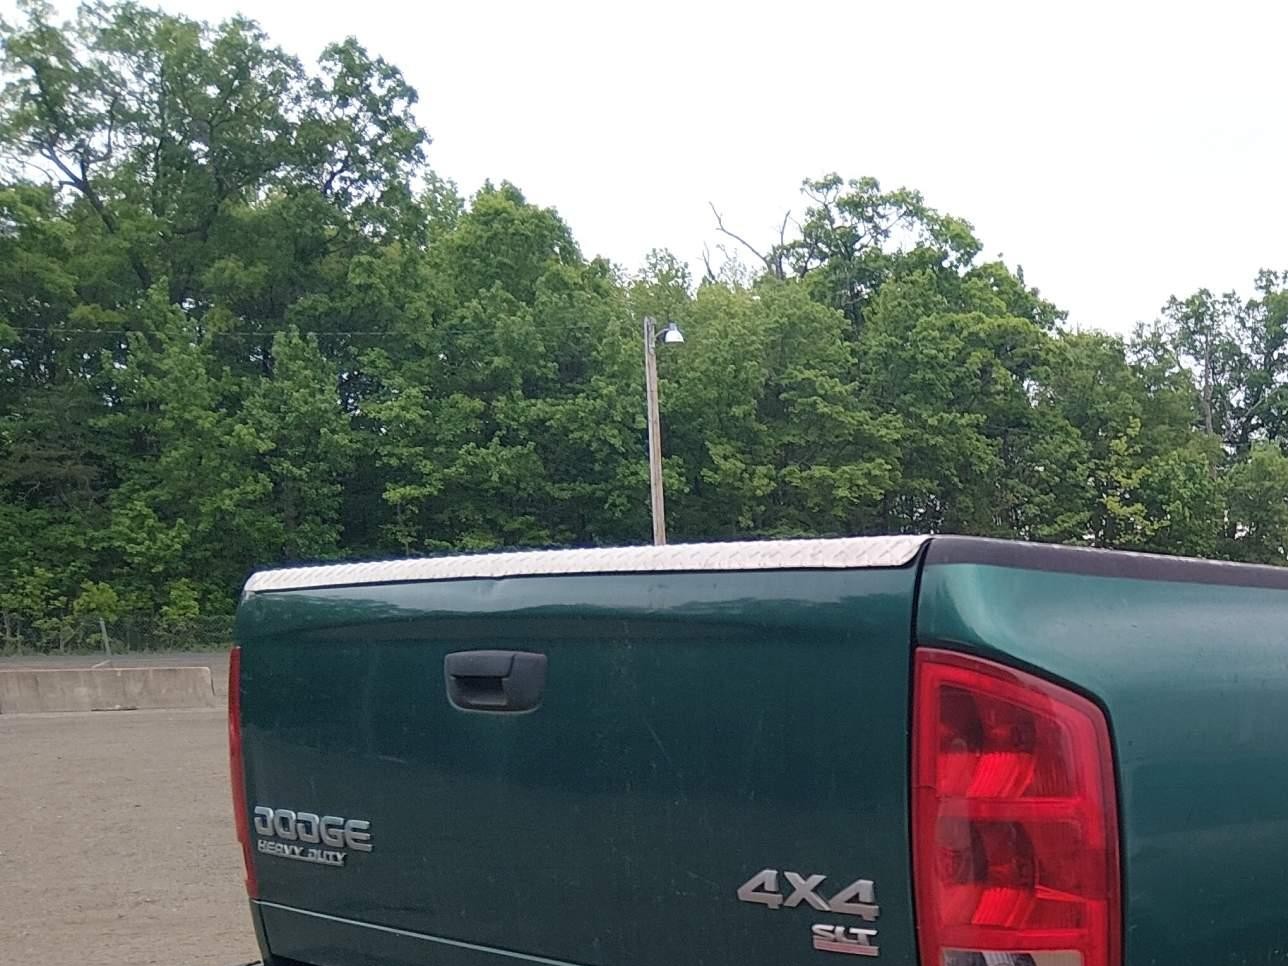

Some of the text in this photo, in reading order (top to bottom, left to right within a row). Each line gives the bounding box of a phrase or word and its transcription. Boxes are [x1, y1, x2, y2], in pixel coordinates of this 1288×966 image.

[254, 806, 373, 852] DODGE
[257, 839, 347, 866] HEAVY DUTY
[811, 923, 878, 947] SLT
